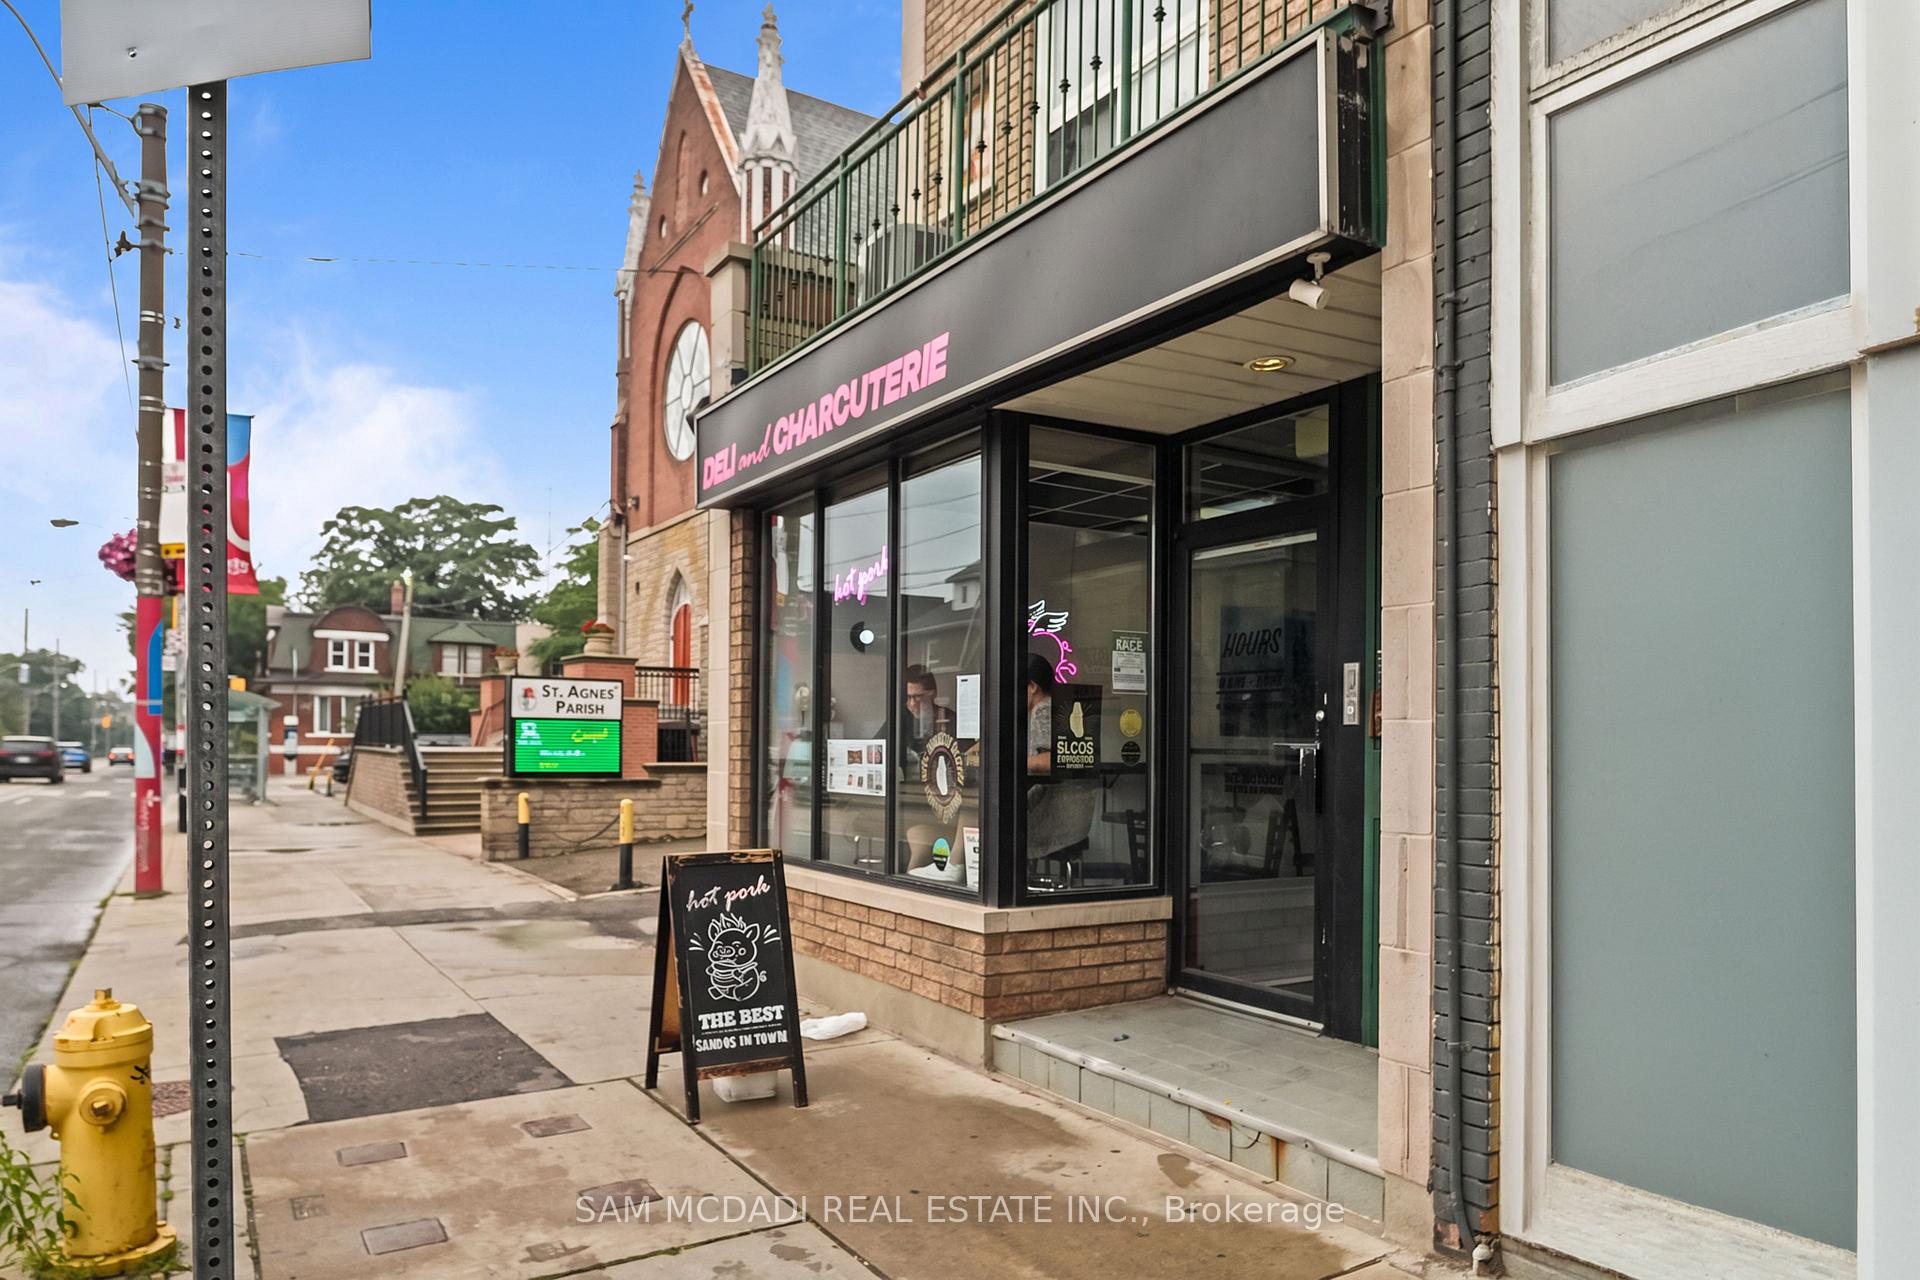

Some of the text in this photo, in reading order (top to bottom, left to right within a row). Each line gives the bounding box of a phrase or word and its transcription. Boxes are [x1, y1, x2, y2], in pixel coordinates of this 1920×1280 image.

[703, 332, 949, 490] DELI and CHARCUTERIE
[834, 567, 857, 602] hot
[1116, 638, 1143, 652] RACE
[1223, 628, 1282, 658] HOURS
[568, 685, 615, 699] AGNES
[556, 701, 604, 715] PARISH
[686, 874, 771, 912] hot pork
[698, 1010, 737, 1030] THE
[739, 1005, 784, 1025] BEST
[695, 1030, 788, 1052] SANDOS IN TOWN
